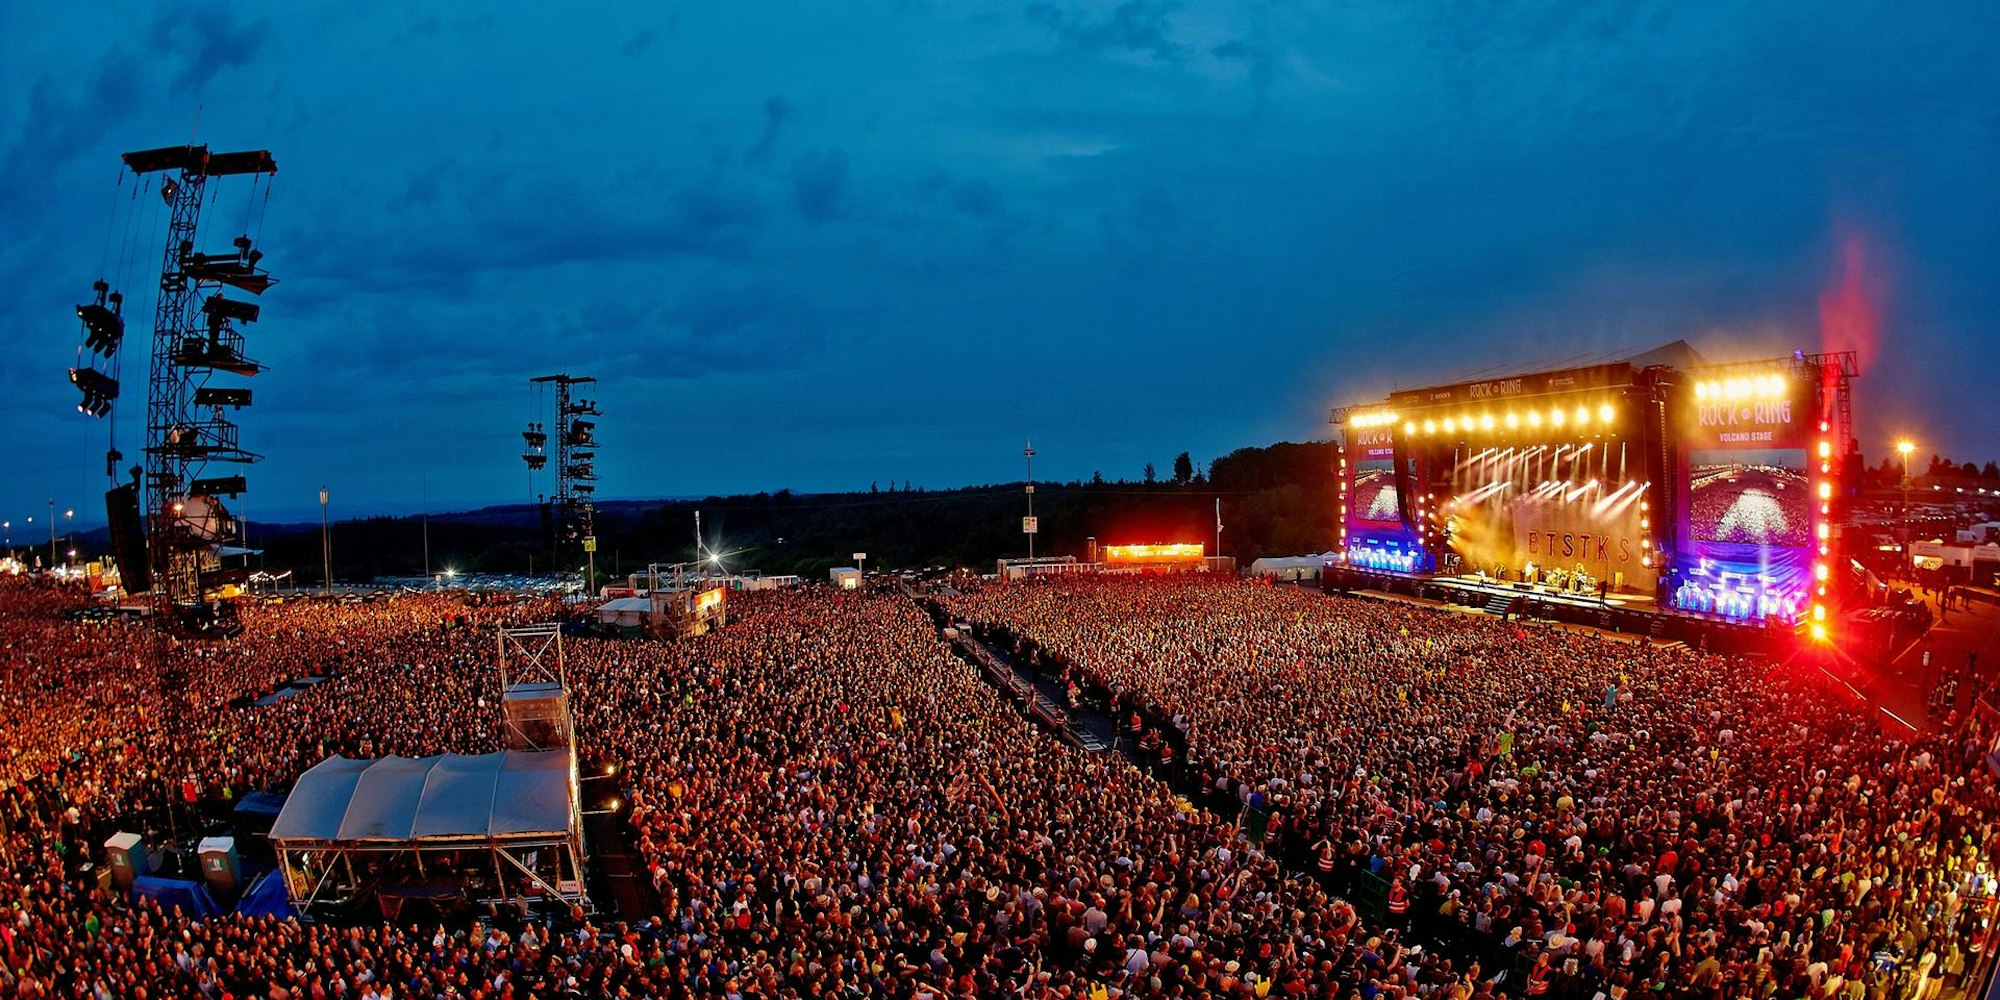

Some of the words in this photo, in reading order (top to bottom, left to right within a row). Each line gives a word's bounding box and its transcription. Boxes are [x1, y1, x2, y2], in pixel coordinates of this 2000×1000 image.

[1469, 382, 1493, 398] ROCK
[1500, 378, 1522, 396] RING
[1698, 404, 1739, 427] ROCK
[1754, 399, 1792, 425] RING
[1719, 432, 1750, 442] VOLCANO
[1751, 431, 1773, 441] STAGE
[1528, 530, 1631, 564] BTSTKS
